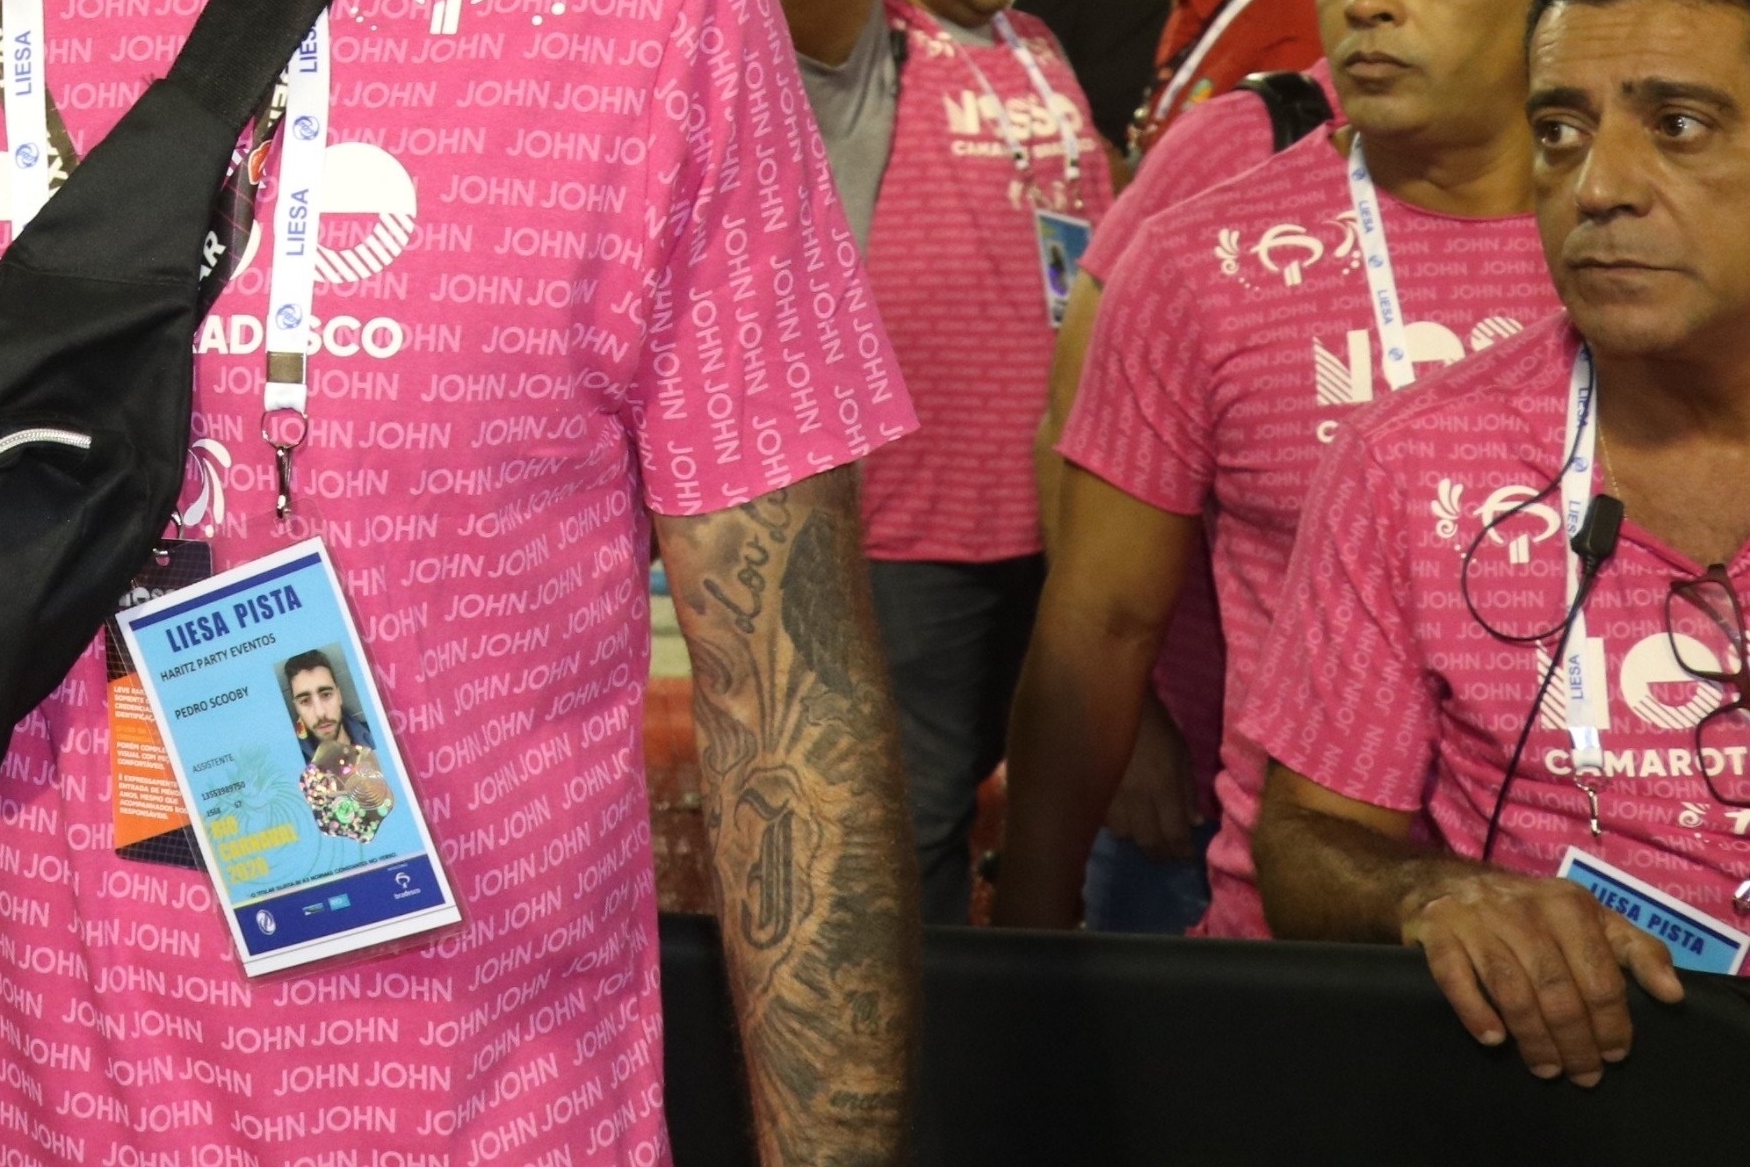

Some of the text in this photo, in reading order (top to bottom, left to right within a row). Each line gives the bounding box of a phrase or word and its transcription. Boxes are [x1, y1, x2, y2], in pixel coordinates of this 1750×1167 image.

[14, 31, 32, 96] LIESA
[411, 32, 616, 65] JOHN JOHN
[55, 81, 141, 111] JOHN
[343, 79, 646, 116] JOHN JOHN JOHN
[506, 129, 602, 162] JOHN
[440, 175, 629, 213] JOHN JOHN
[756, 144, 788, 233] JOHN
[286, 188, 309, 256] LIESA
[1358, 200, 1374, 234] LIESA
[494, 227, 587, 259] JOHN
[722, 214, 756, 302] JOHN
[1443, 238, 1499, 253] JOHN
[429, 273, 523, 305] JOHN
[768, 255, 801, 342] JOHN
[1377, 289, 1393, 325] LIESA
[689, 287, 725, 374] JOHN
[809, 278, 845, 364] JOHN
[481, 326, 569, 355] JOHN
[736, 308, 769, 396] JOHN
[853, 318, 894, 404] JOHN
[306, 369, 506, 402] JOHN JOHN
[651, 340, 688, 420] JOHN
[782, 348, 822, 434] JOHN
[359, 416, 547, 450] JOHN JOHN
[704, 380, 741, 464] JOHN
[1474, 414, 1531, 433] JOHN
[305, 466, 491, 499] JOHN JOHN
[358, 513, 438, 547] JOHN
[1566, 499, 1581, 534] LIES
[400, 534, 549, 587] JOHN JOHN
[444, 590, 528, 622] JOHN
[1482, 590, 1544, 610] JOHN
[166, 585, 302, 653] LIESA PISTA
[161, 633, 276, 681] HARITZ PARTY EVENTOS
[471, 625, 550, 660] JOHN
[454, 651, 581, 717] JOHN JOHN
[1459, 682, 1523, 701] JOHN
[1569, 654, 1583, 700] LIESA
[175, 700, 208, 719] PEDRO
[210, 686, 249, 709] SCOOBY
[193, 754, 235, 773] ASSISTENTE
[519, 733, 572, 782] JOHN
[1608, 801, 1672, 825] JOHN
[469, 822, 591, 902] JOHN JOHN
[1622, 848, 1689, 870] JOHN
[96, 870, 168, 905] JOHN
[124, 921, 200, 958] JOHN
[1647, 913, 1705, 955] PISTA
[18, 944, 88, 982] JOHN
[171, 972, 453, 1008] JOHN JOHN JOHN
[131, 1010, 399, 1054] JOHN JOHN JOHN
[24, 1034, 174, 1087] JOHN JOHN
[273, 1061, 451, 1097] JOHN JOHN
[489, 1052, 559, 1108] JOHN
[56, 1090, 396, 1142] JOHN JOHN JOHN JOHN
[467, 1112, 538, 1166] JOHN
